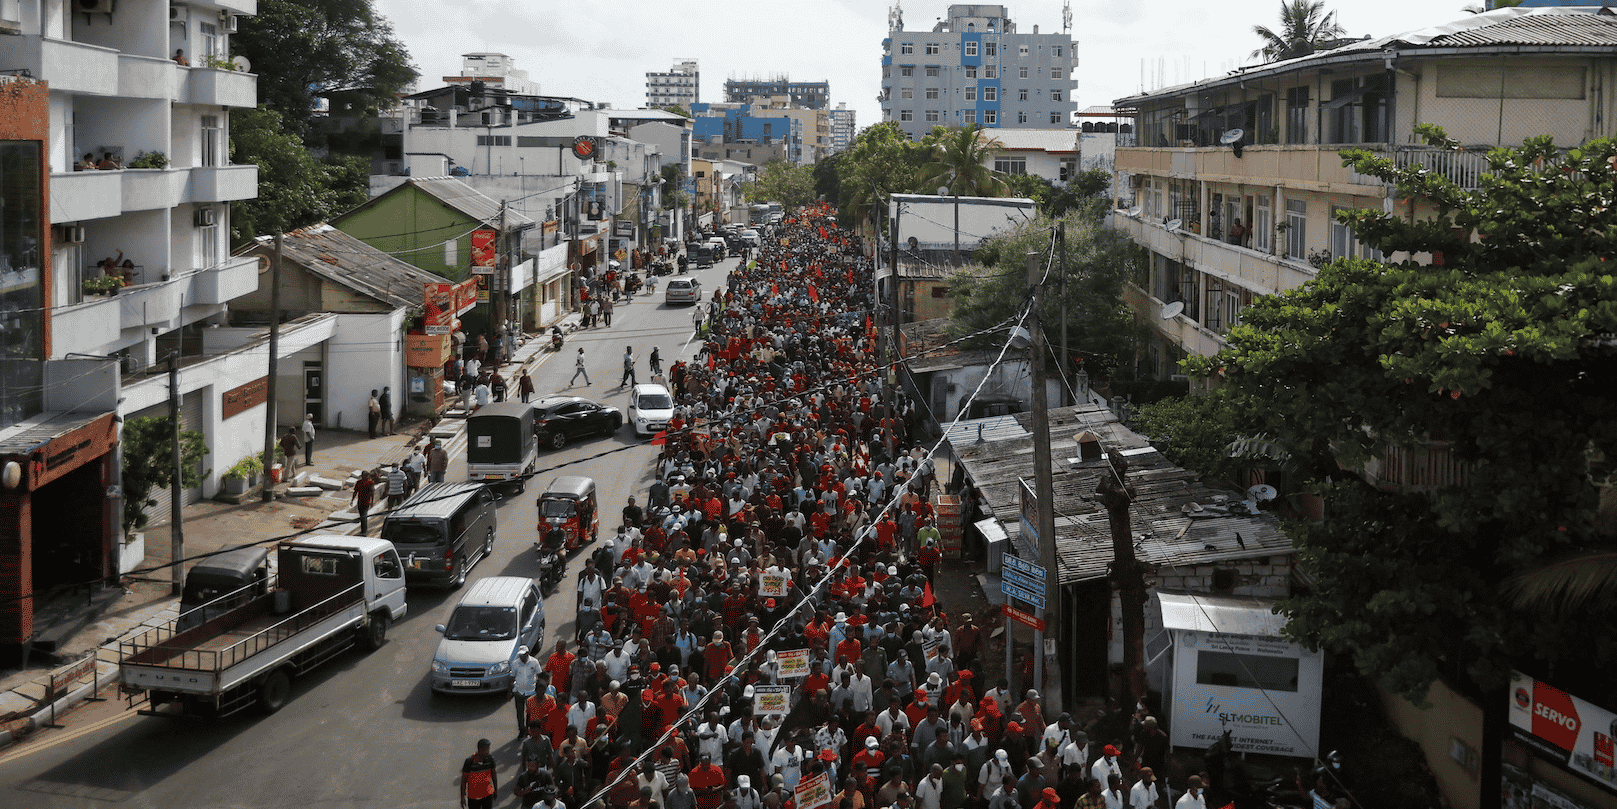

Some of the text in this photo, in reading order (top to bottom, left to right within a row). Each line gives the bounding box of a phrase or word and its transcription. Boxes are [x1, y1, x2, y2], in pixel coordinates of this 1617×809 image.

[1534, 703, 1577, 731] SERVO
[1239, 737, 1274, 745] INTERNET
[1256, 745, 1294, 753] COVERAGE
